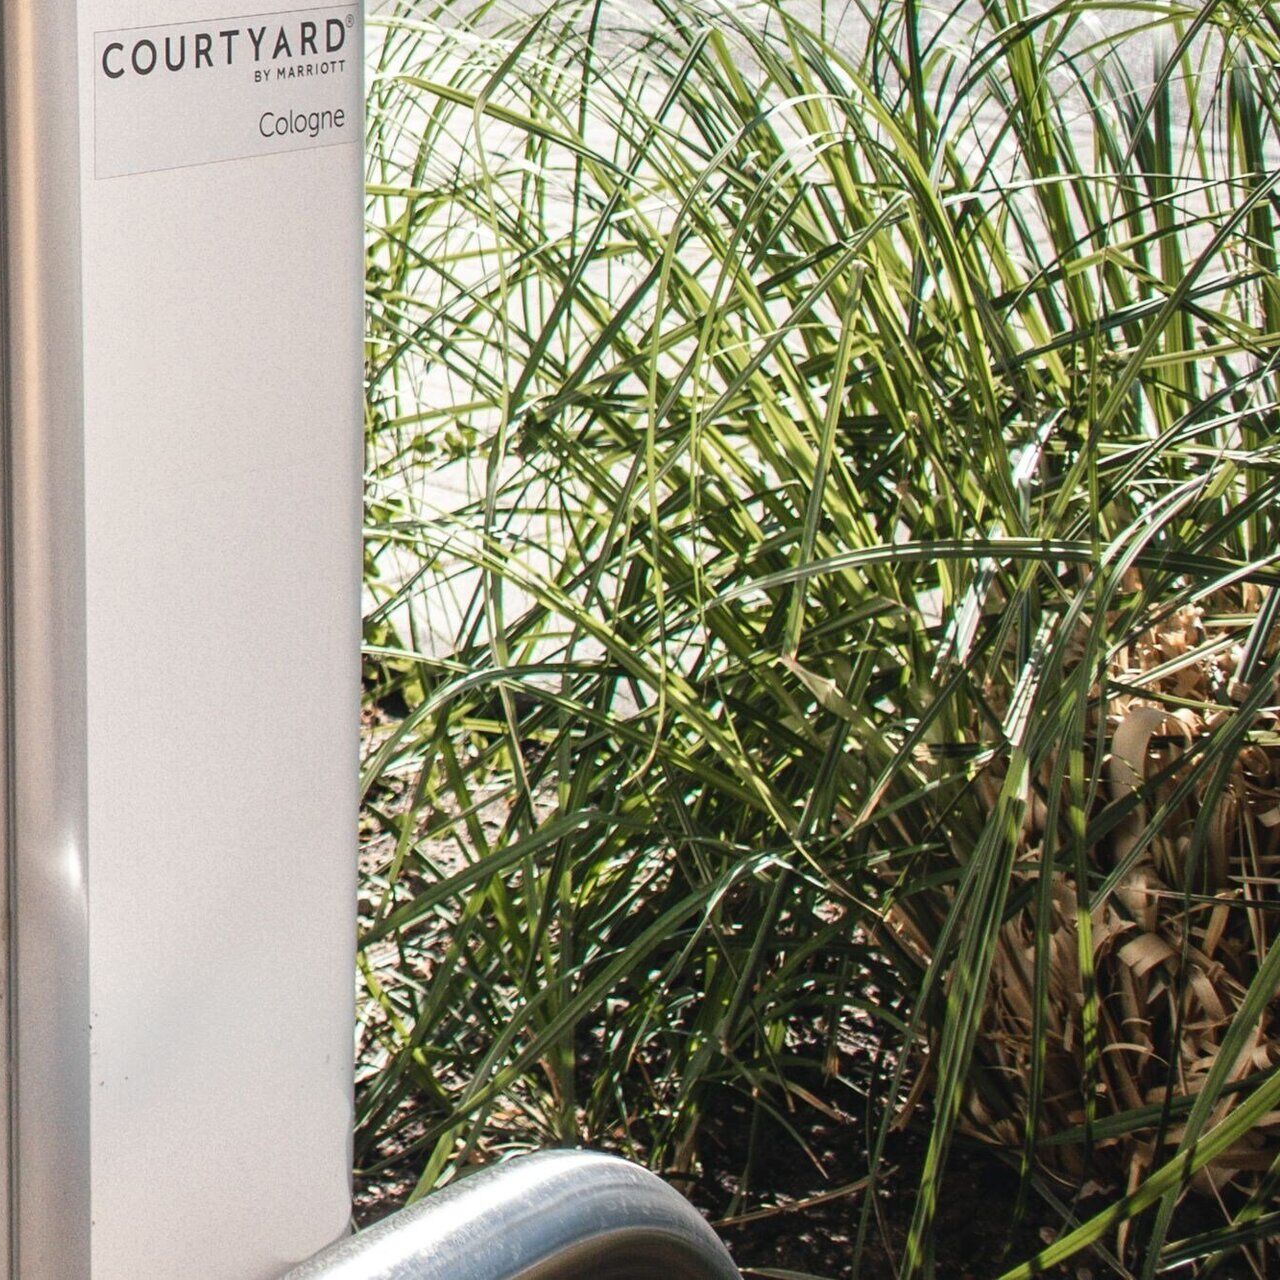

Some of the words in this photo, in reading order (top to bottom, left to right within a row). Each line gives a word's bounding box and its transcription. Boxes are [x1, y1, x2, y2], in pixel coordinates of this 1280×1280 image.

[254, 69, 271, 83] BY
[276, 59, 346, 80] MARRIOTT
[259, 108, 345, 138] Cologne
